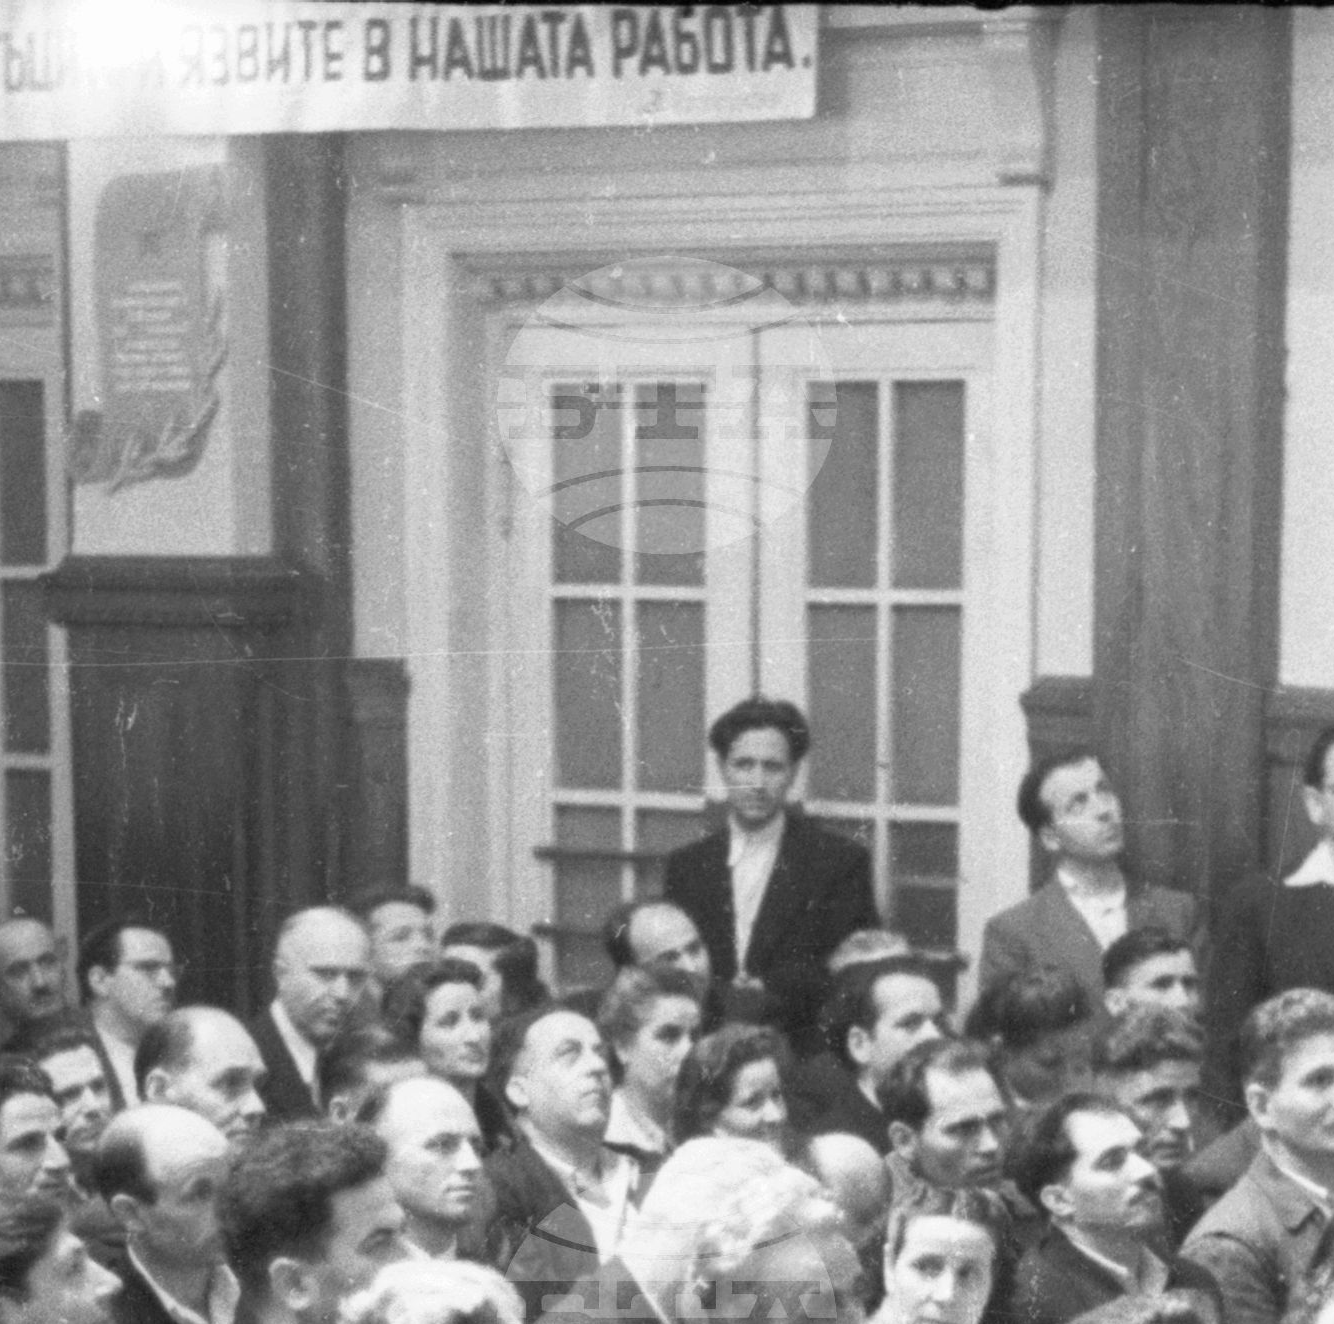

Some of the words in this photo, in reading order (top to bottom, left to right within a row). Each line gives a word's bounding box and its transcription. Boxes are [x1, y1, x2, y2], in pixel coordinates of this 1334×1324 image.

[364, 17, 391, 82] В
[408, 10, 595, 82] НАШАТА
[611, 4, 813, 79] РАБОТА.
